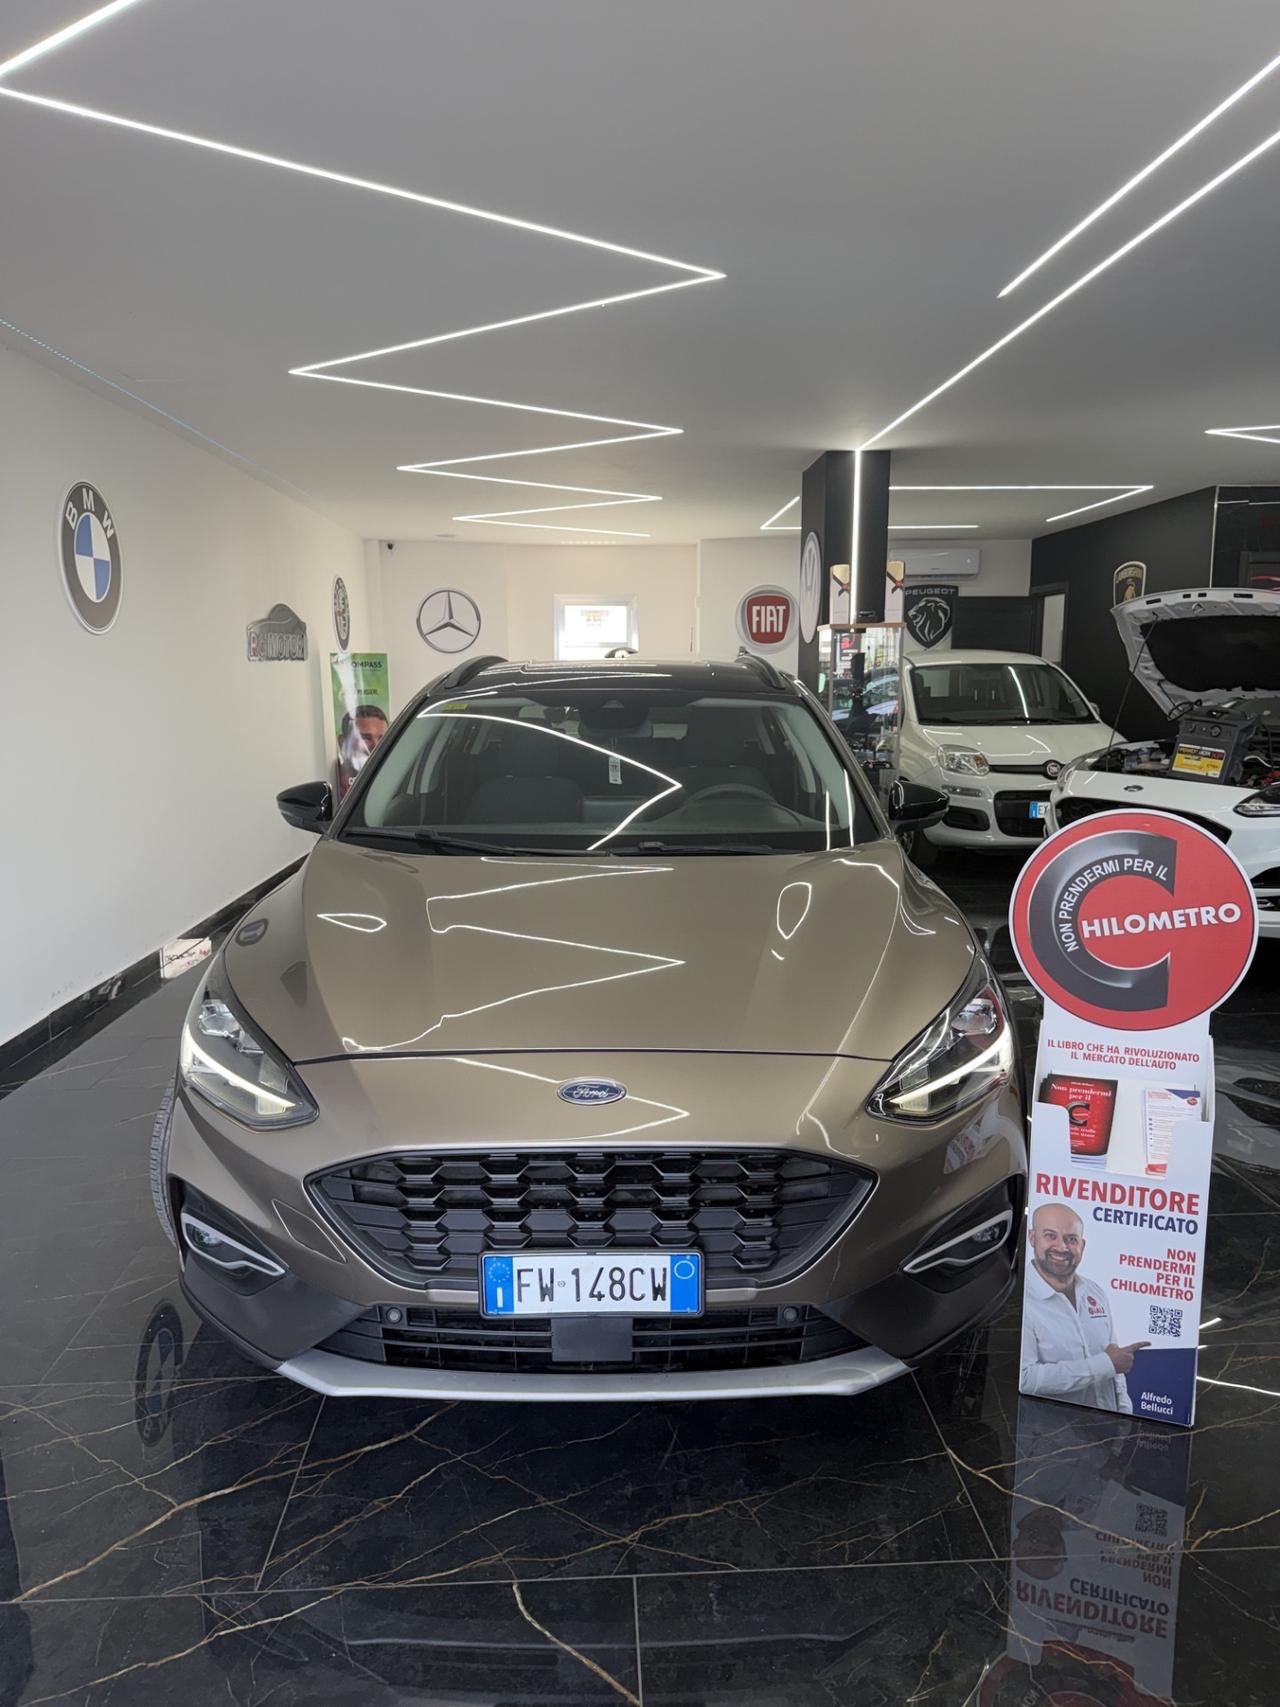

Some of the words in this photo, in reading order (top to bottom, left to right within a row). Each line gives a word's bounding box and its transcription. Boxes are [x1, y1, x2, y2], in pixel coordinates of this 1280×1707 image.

[65, 487, 114, 538] BMW
[904, 587, 956, 596] PEUGEOT
[752, 605, 786, 633] FIAT
[1123, 857, 1154, 873] PER
[1155, 864, 1169, 881] IL
[1059, 859, 1120, 920] PRENDERMI
[1081, 902, 1241, 939] HILOMETRO
[1060, 922, 1079, 953] NON
[1047, 1039, 1056, 1048] IL
[1057, 1040, 1084, 1051] LIBRO
[1086, 1042, 1105, 1053] CHE
[1106, 1045, 1120, 1055] HA
[1124, 1046, 1200, 1063] RIVOLUZIONATO
[1071, 1051, 1079, 1061] IL
[1082, 1052, 1126, 1066] MERCATO
[1128, 1057, 1177, 1071] DELL'AUTO
[573, 1083, 610, 1100] Ford
[1069, 1086, 1112, 1097] prendermi
[1035, 1172, 1200, 1216] RIVENDITORE
[1092, 1206, 1199, 1235] CERTIFICATO
[1119, 1253, 1196, 1276] PRENDERMI
[1166, 1248, 1197, 1263] NON
[516, 1267, 555, 1303] FW
[571, 1266, 668, 1302] 148CW
[1110, 1277, 1194, 1302] CHILOMETRO
[1156, 1272, 1181, 1287] PER
[1183, 1275, 1196, 1289] IL
[1140, 1391, 1173, 1405] Alfredo
[1140, 1400, 1174, 1416] Bellucci
